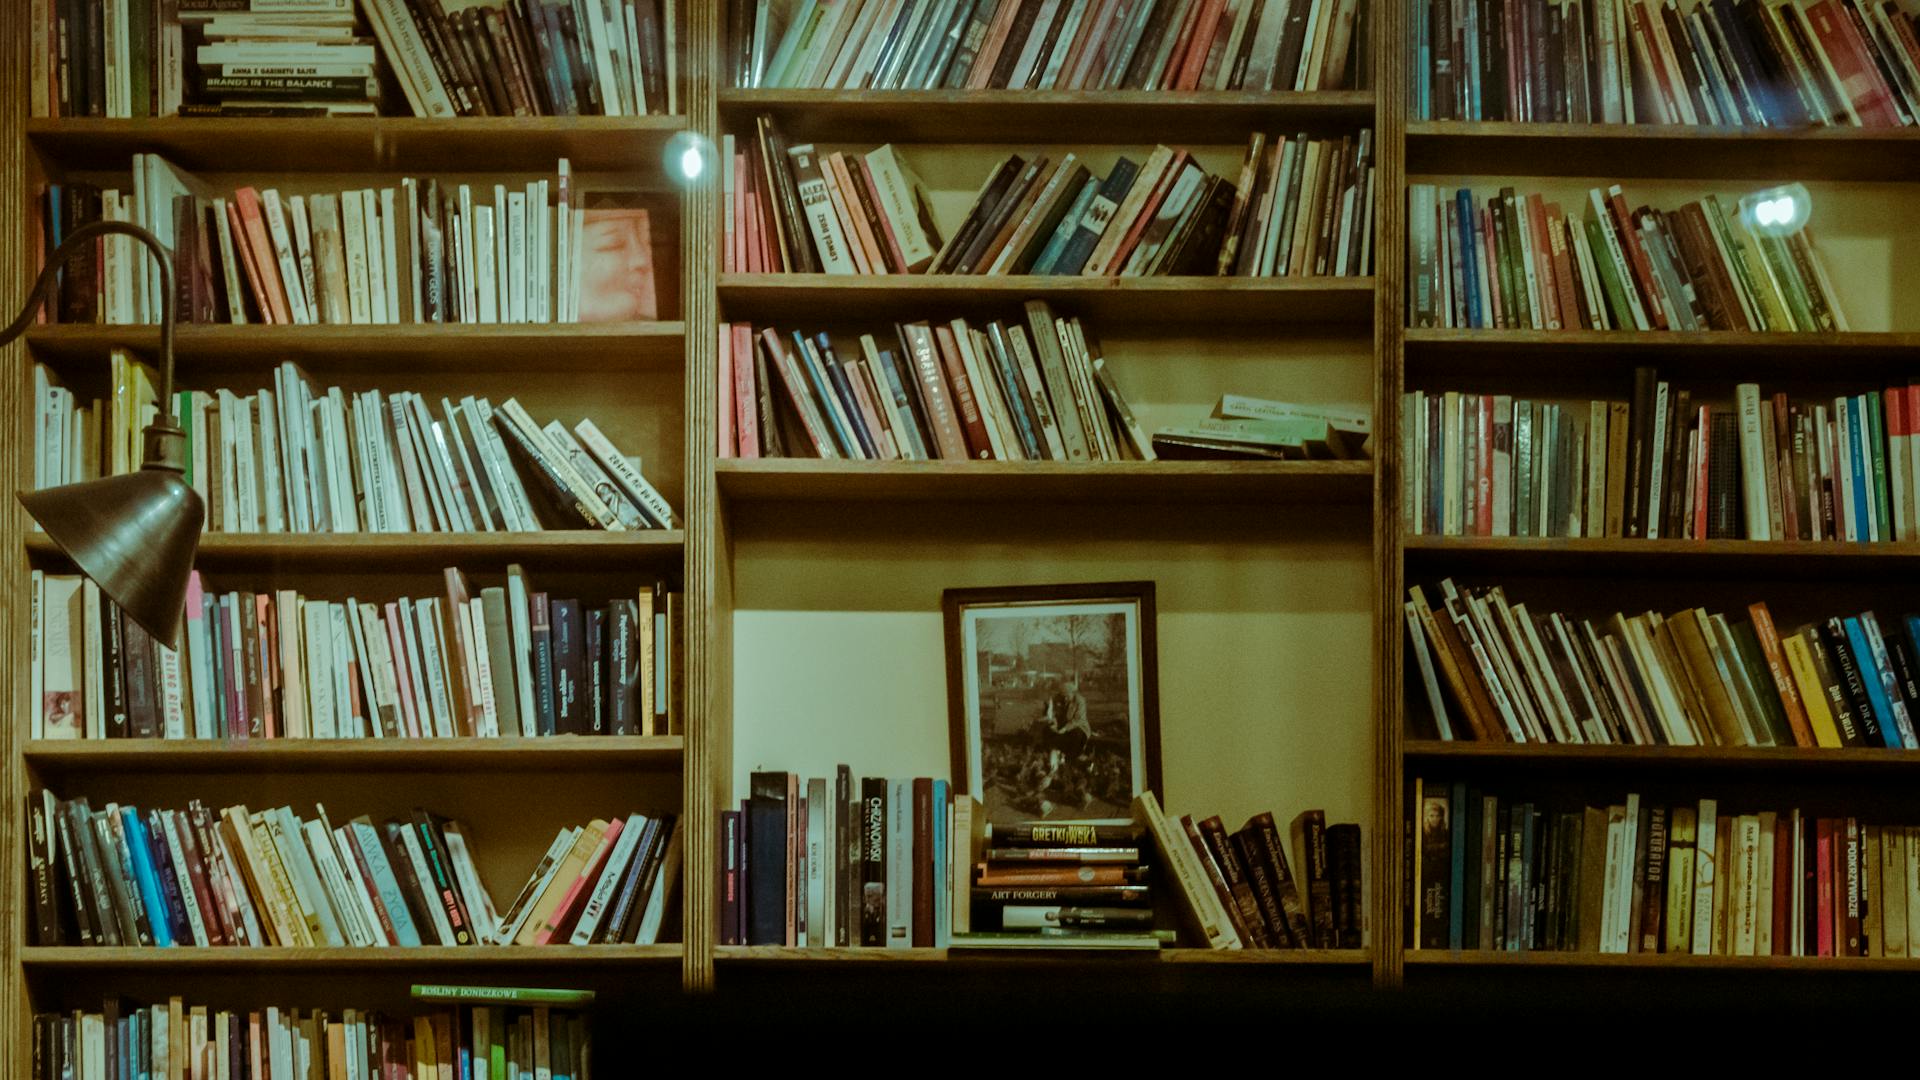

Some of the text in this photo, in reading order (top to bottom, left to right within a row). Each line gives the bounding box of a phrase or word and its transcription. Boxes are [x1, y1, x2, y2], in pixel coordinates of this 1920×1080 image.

[207, 79, 248, 87] BRANDS
[251, 79, 261, 87] IN
[287, 80, 333, 88] BALANCE
[512, 214, 521, 255] WILLIAMS
[1795, 433, 1804, 454] Kerr
[164, 653, 179, 721] BLING RING
[1836, 644, 1877, 735] MICHALAK DRAŃ
[1838, 712, 1857, 740] ŚWIATA
[871, 797, 881, 861] CHRZANOWSKI
[1311, 825, 1323, 879] Encyclopedia
[1647, 808, 1664, 881] PROKURATOR
[1263, 829, 1284, 881] Encyclopedia
[1848, 841, 1857, 917] PODKRZYWDZIE
[379, 885, 414, 931] ŻYCIA
[992, 891, 1057, 900] ART FORGERY
[421, 987, 517, 998] ROŚLINY DONICZKOWE
